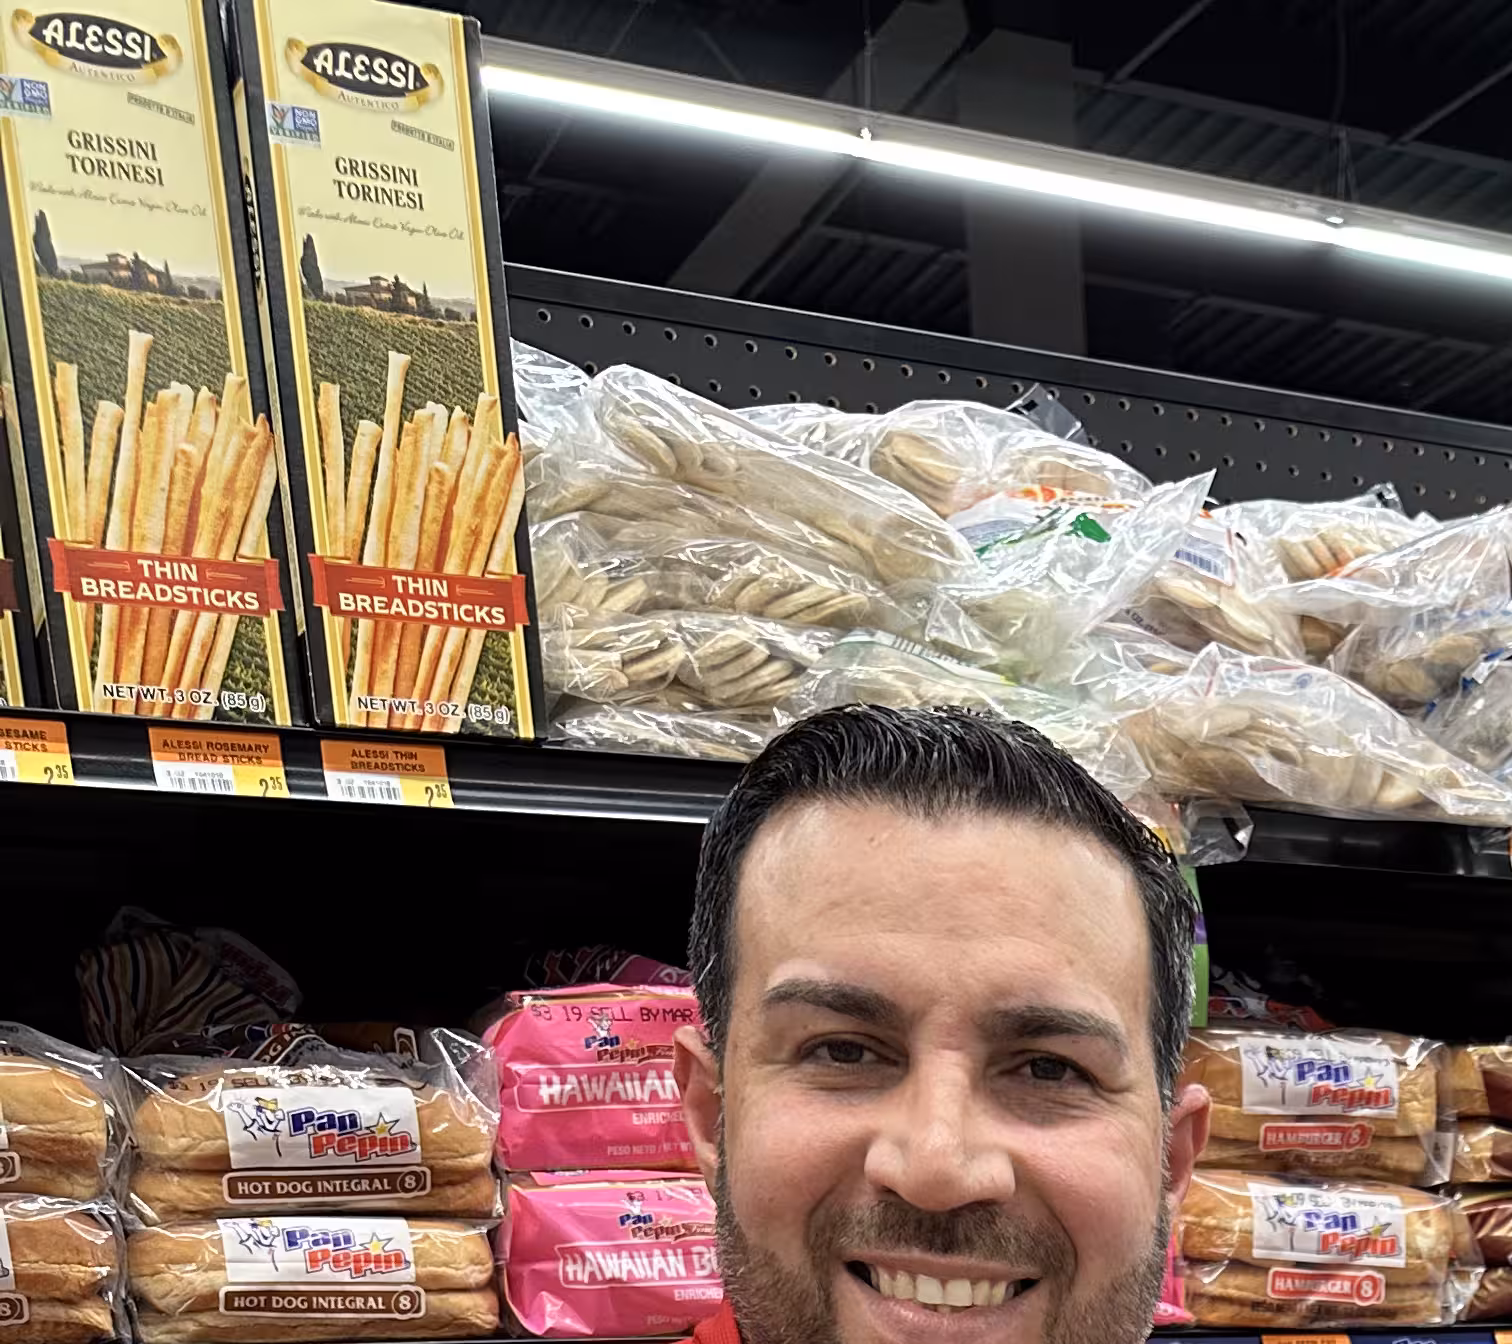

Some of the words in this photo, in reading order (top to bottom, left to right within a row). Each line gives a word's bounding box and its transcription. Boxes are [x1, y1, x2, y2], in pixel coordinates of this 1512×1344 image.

[43, 19, 151, 61] ALESSI
[313, 48, 415, 90] ALESSI
[67, 129, 157, 161] GRISSINI
[66, 153, 164, 187] TORINESI
[335, 156, 419, 187] GRISSINI
[333, 179, 425, 211] TORINESI
[137, 559, 199, 582] THIN
[80, 577, 260, 611] BREADSTICKS
[391, 575, 448, 597] THIN
[338, 593, 506, 625] BREADSTICKS
[103, 684, 137, 700] NET
[141, 687, 173, 703] WT.
[175, 689, 185, 703] 3
[189, 690, 218, 706] OZ.
[357, 696, 386, 710] NET
[395, 699, 423, 713] WT.
[425, 701, 434, 715] 3
[439, 703, 467, 718] OZ.
[206, 741, 270, 754] ROSEMARY
[222, 754, 263, 765] STICKS
[350, 761, 426, 773] BREADSTICKS
[564, 1006, 583, 1022] 19
[584, 1033, 621, 1051] Pan
[1295, 1058, 1352, 1084] Pan
[288, 1107, 364, 1137] Pan
[308, 1132, 417, 1162] Pepin
[238, 1181, 273, 1196] HOT
[276, 1180, 313, 1196] DOG
[317, 1177, 392, 1195] INTEGRAL
[1303, 1209, 1360, 1232] Pan
[281, 1225, 356, 1252] Pan
[304, 1247, 412, 1280] Pepin
[563, 1247, 687, 1282] HAWAIIAN
[233, 1294, 267, 1310] HOT
[271, 1295, 308, 1311] DOG
[312, 1294, 386, 1311] INTEGRAL
